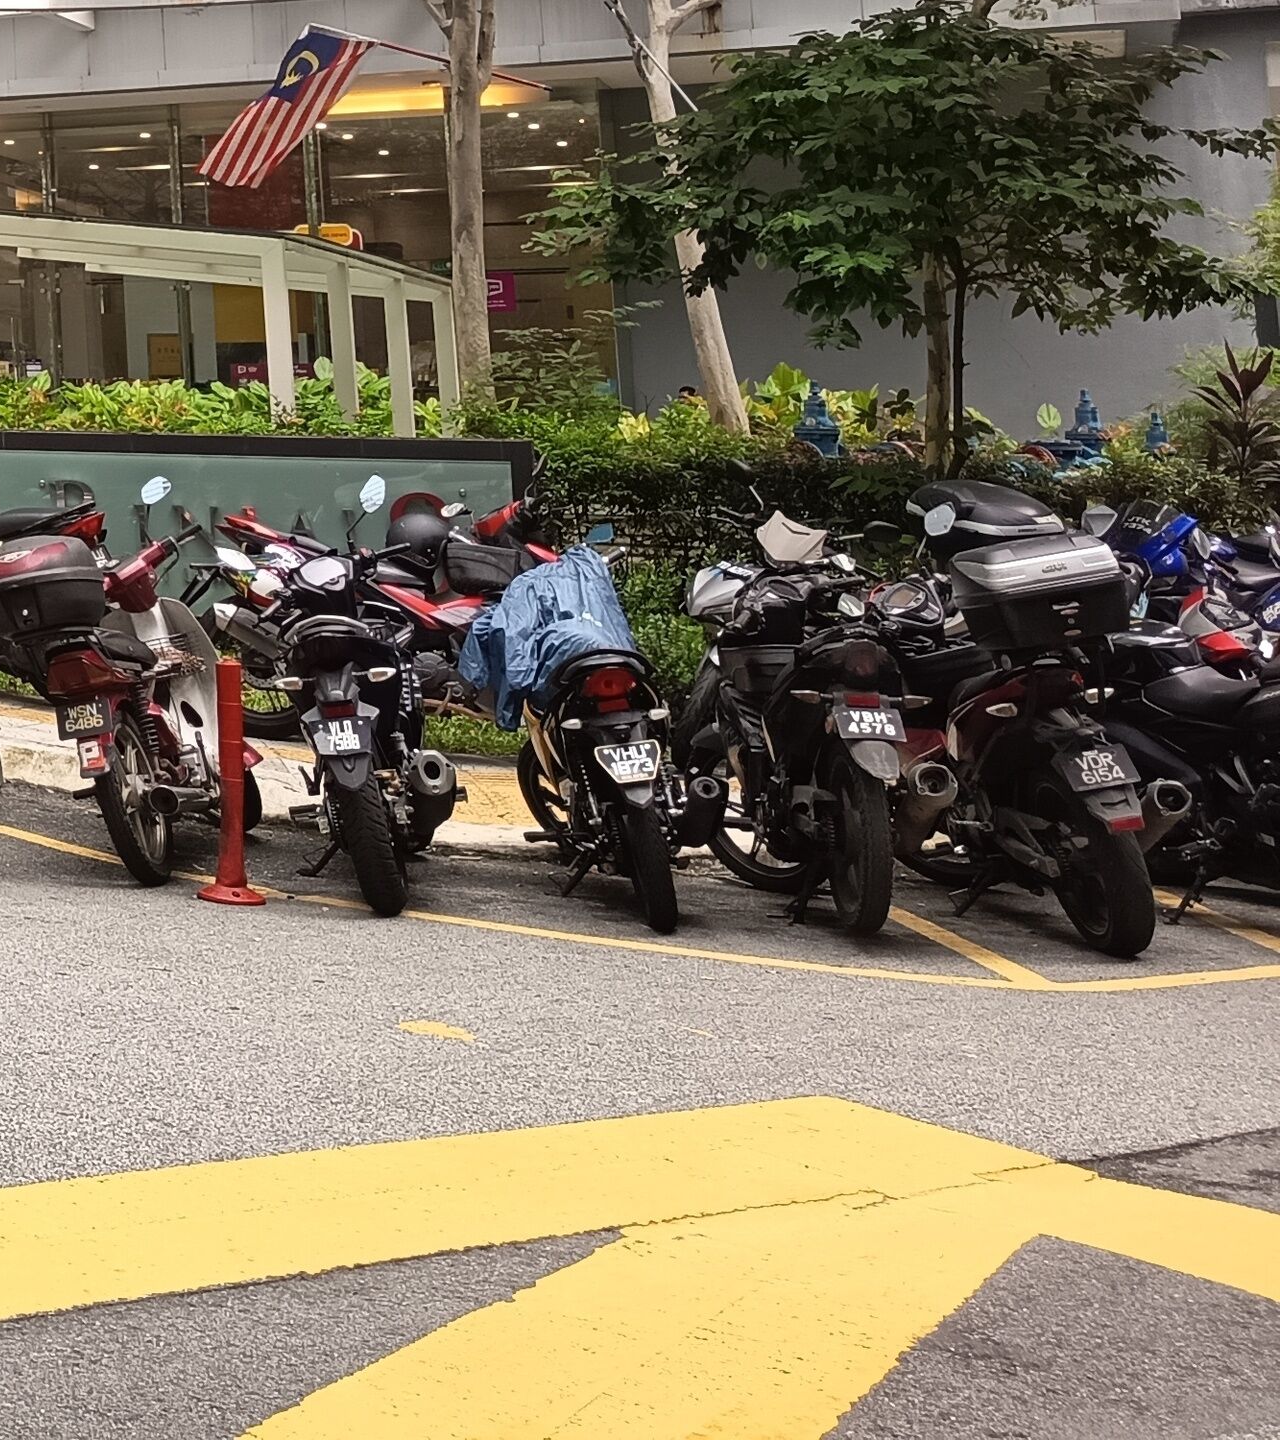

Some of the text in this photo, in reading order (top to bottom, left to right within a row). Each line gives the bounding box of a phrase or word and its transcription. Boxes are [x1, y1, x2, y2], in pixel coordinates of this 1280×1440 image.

[67, 703, 97, 719] WSN
[849, 710, 888, 724] VBH
[65, 714, 104, 733] 6486
[848, 721, 896, 736] 4578
[609, 745, 647, 762] VHU
[1075, 752, 1116, 770] VDR
[611, 757, 655, 776] 1873
[1081, 765, 1126, 785] 6154
